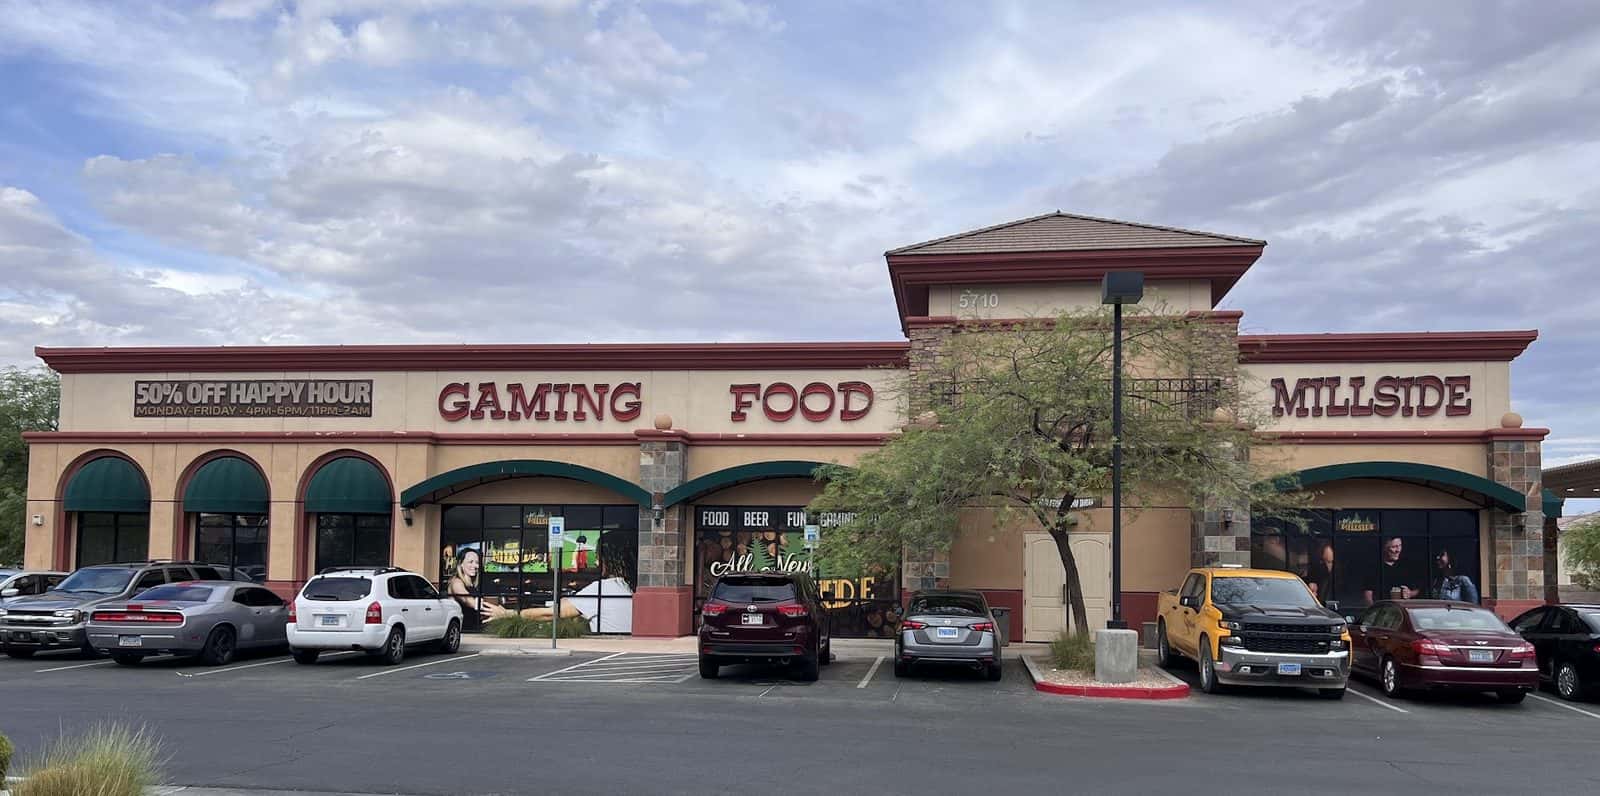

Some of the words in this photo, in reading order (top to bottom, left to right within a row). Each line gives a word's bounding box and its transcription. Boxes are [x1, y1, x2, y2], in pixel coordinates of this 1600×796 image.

[959, 294, 998, 308] 5710
[136, 383, 183, 404] 50%
[186, 383, 227, 404] OFF
[230, 382, 305, 404] HAPPY
[307, 382, 371, 404] HOUR
[438, 382, 642, 422] GAMING
[730, 381, 875, 422] FOOD
[1270, 375, 1472, 418] MILLSIDE
[702, 511, 730, 526] FOOD
[743, 511, 769, 527] BEER
[786, 511, 807, 527] FUN
[710, 551, 754, 577] All
